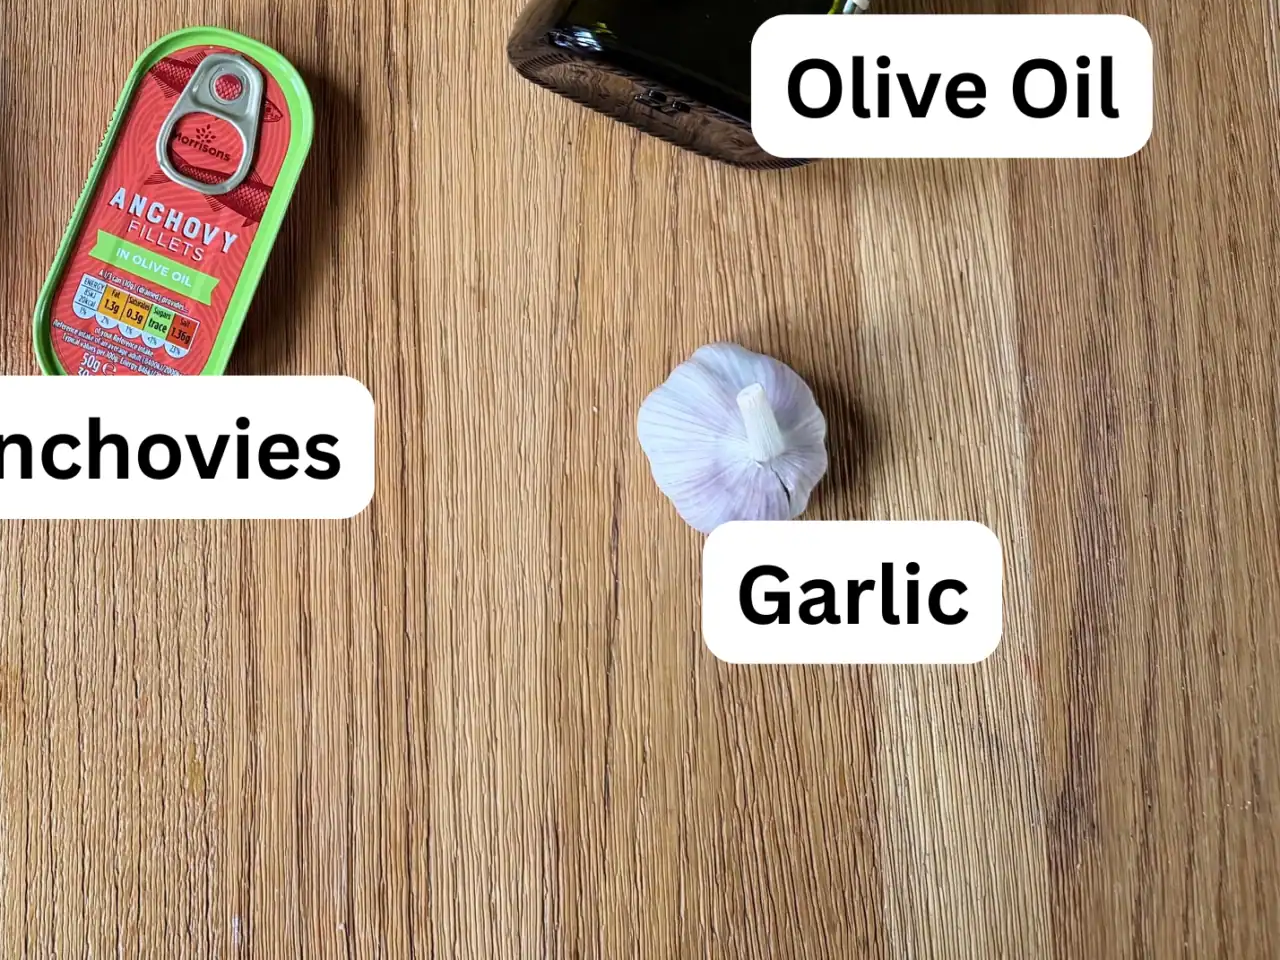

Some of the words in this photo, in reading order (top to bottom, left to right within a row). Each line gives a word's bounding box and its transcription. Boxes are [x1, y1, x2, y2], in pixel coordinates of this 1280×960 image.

[109, 187, 238, 254] ANCHOVY
[127, 218, 205, 261] FILLETS
[116, 247, 130, 260] IN
[132, 255, 169, 277] OLIVE
[171, 271, 192, 288] OIL
[83, 277, 105, 292] ENERGY
[111, 289, 121, 299] Fat
[104, 299, 120, 315] 1.3g
[129, 296, 150, 311] Saturates
[126, 308, 144, 325] 0.3g
[153, 306, 172, 320] Sugars
[53, 319, 79, 335] Reference
[148, 318, 168, 334] trace
[179, 317, 190, 328] Salt
[113, 334, 139, 349] Reference
[171, 327, 191, 345] 1.36g
[80, 352, 101, 373] 50g
